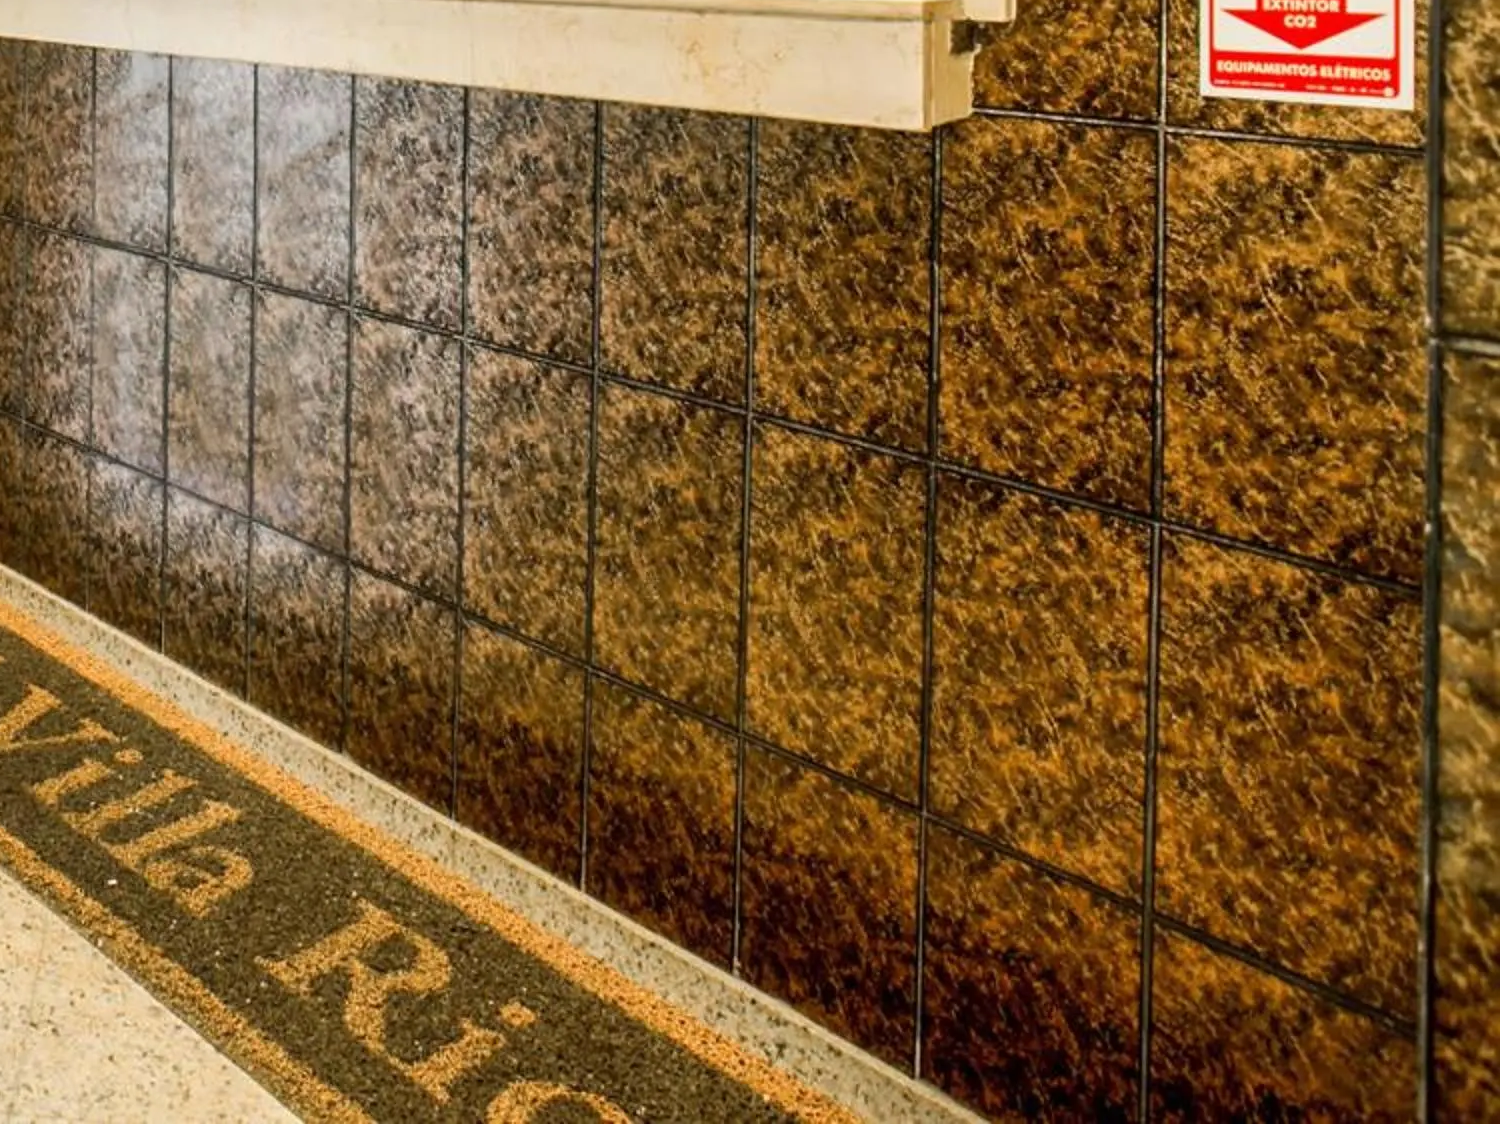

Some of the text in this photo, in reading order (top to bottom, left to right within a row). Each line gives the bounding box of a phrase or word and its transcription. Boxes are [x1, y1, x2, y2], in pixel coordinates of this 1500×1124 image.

[1283, 14, 1317, 29] CO2
[1215, 59, 1392, 82] EQUIPAMENTOS ELÉTRICOS
